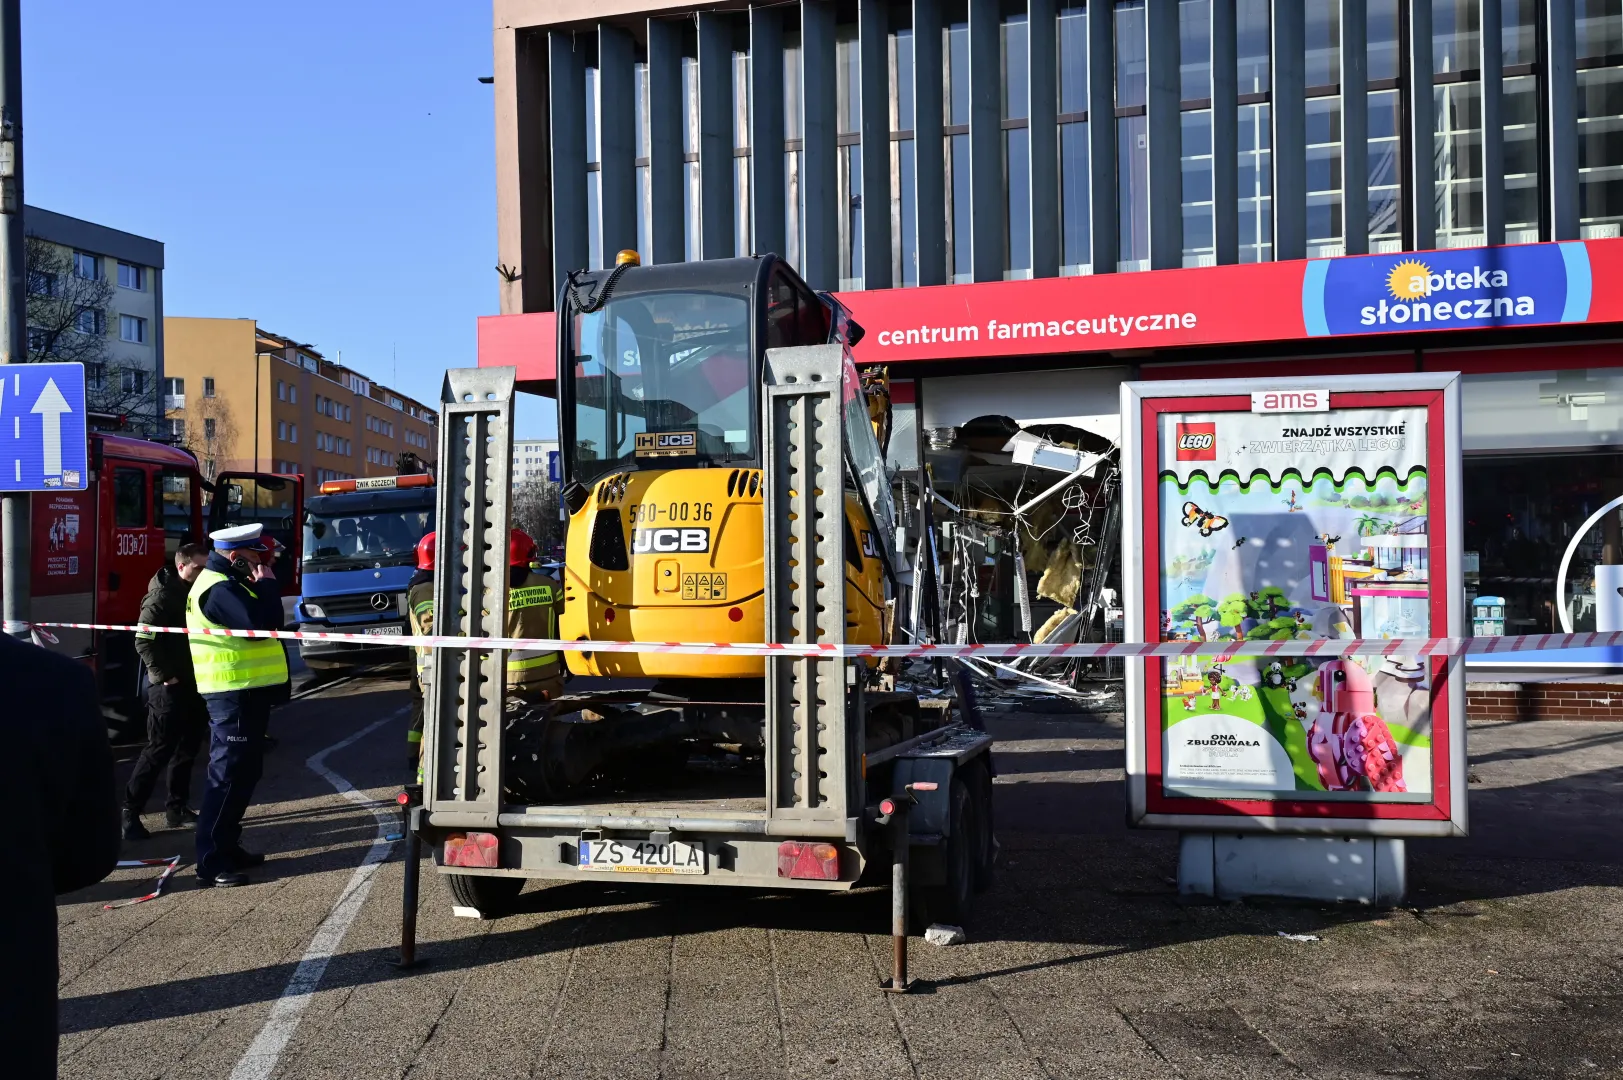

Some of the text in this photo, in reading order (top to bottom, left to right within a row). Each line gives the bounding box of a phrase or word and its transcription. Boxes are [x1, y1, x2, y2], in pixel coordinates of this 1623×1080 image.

[1408, 266, 1508, 297] apteka
[1360, 295, 1535, 325] słoneczna
[877, 312, 1197, 346] centrum farmaceutyczne
[1263, 393, 1318, 409] ams
[1282, 424, 1406, 438] ZNAJDŹ WSZYSTKIE
[637, 436, 654, 447] IH
[659, 434, 693, 446] JCB
[1179, 434, 1213, 449] LEGO
[1249, 437, 1406, 455] ZWIERZĄTKA LEGO!
[370, 479, 396, 488] SZCZECIN
[632, 529, 708, 552] JCB
[593, 841, 700, 867] ZS 420LA
